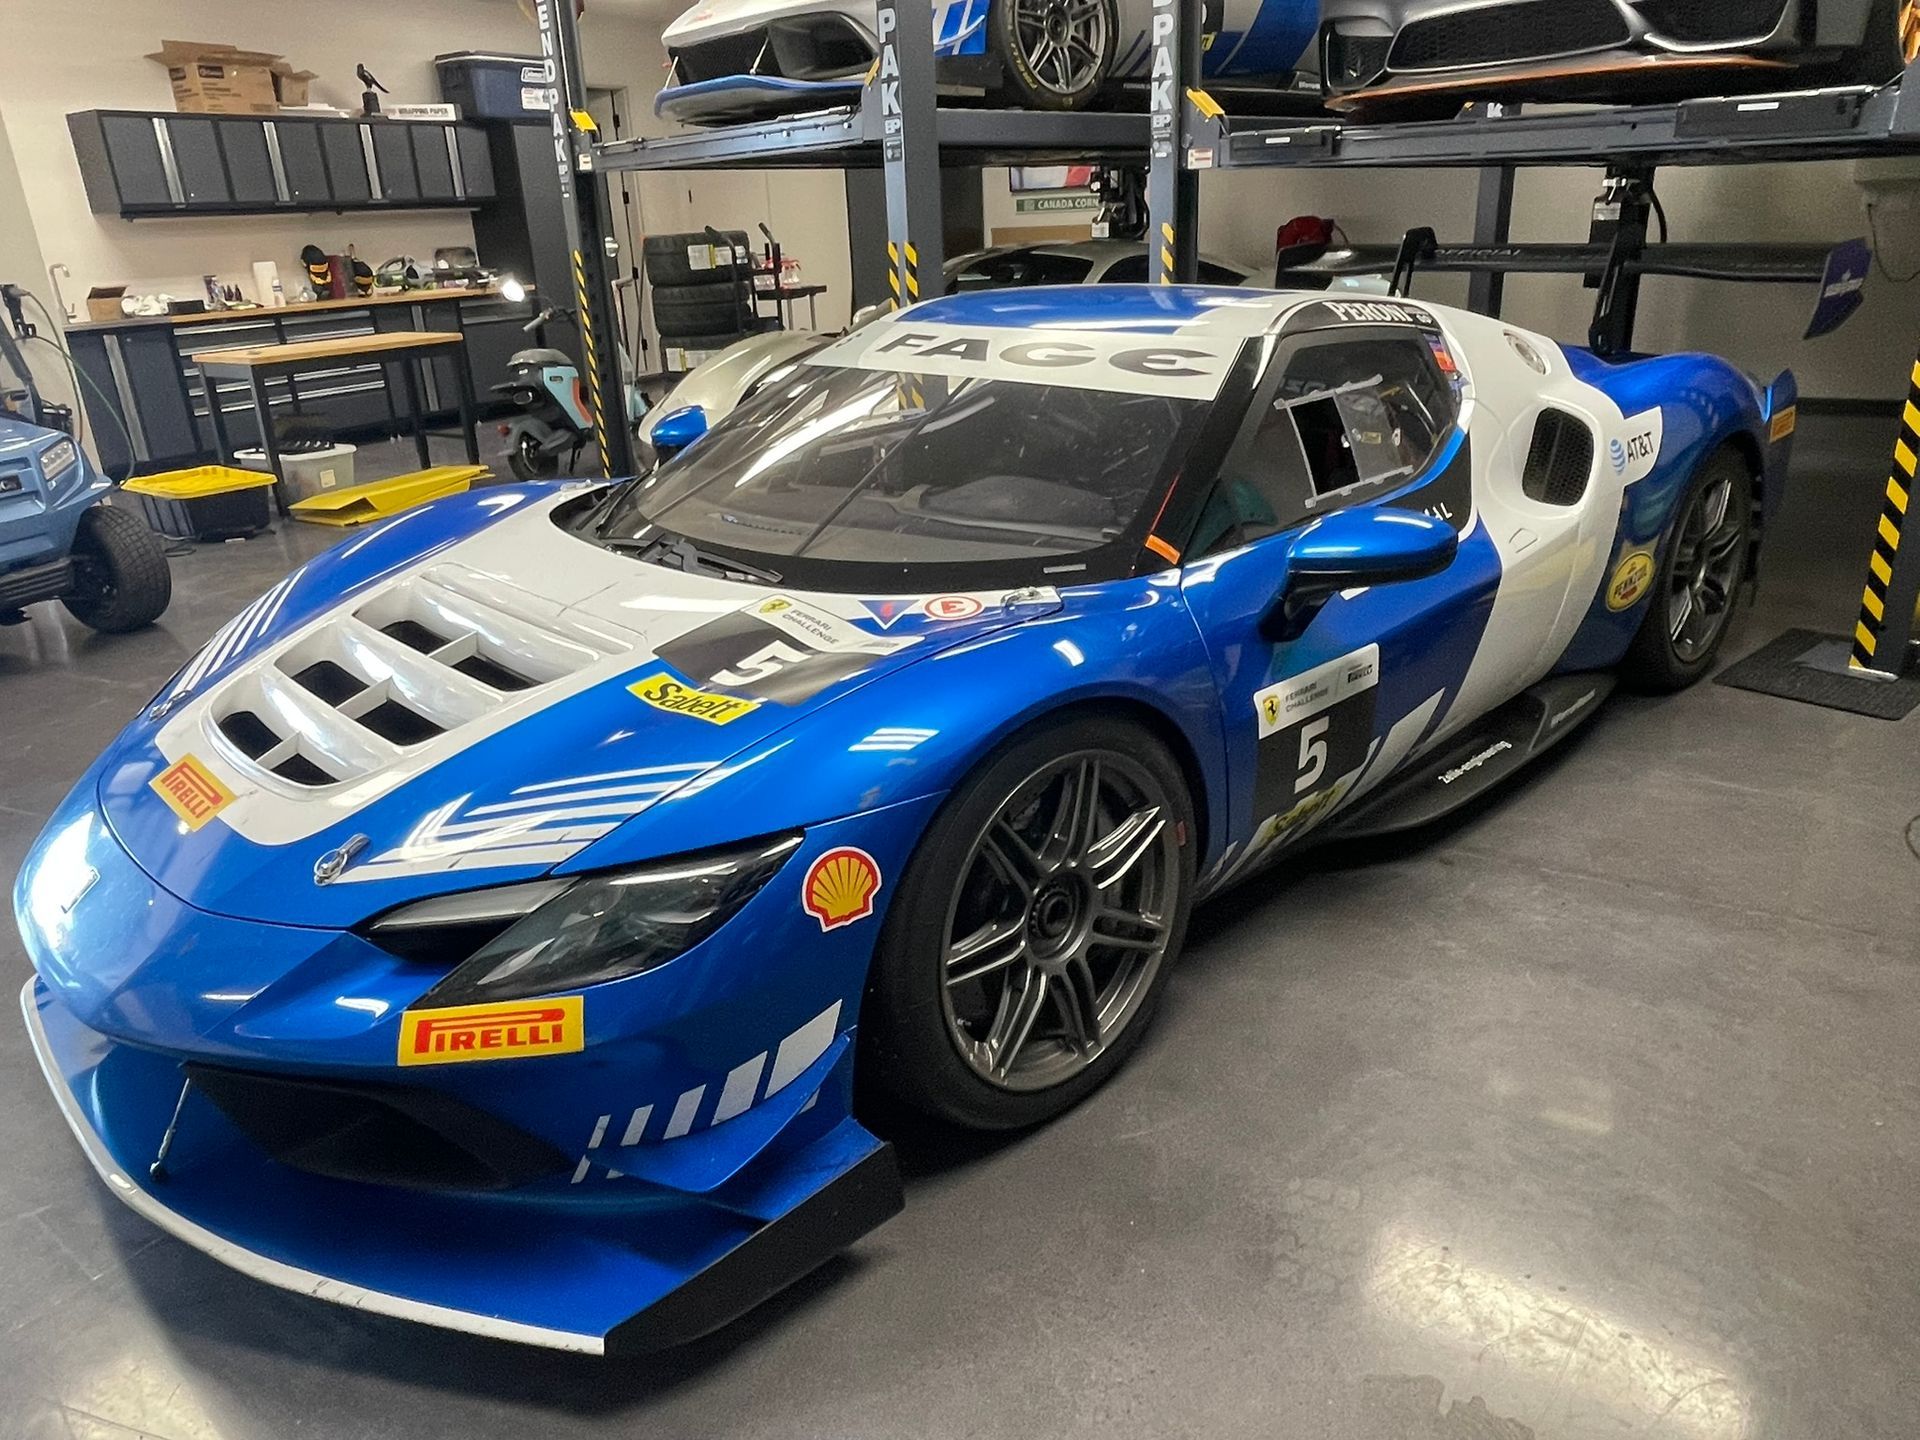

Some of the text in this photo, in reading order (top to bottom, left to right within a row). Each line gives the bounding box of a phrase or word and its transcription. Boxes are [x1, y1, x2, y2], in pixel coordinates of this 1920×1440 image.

[1151, 0, 1174, 112] PAK
[1037, 199, 1073, 210] CANADA
[1322, 301, 1414, 321] PERONI
[1626, 431, 1654, 464] AT&T
[789, 608, 832, 631] FERRARI
[940, 600, 969, 614] E
[781, 613, 840, 645] CHALLENGE
[709, 639, 812, 687] 5
[643, 682, 742, 719] Sabelt
[1294, 715, 1330, 794] 5
[160, 761, 224, 819] PIRELLI
[414, 1008, 566, 1054] PIRELLI
